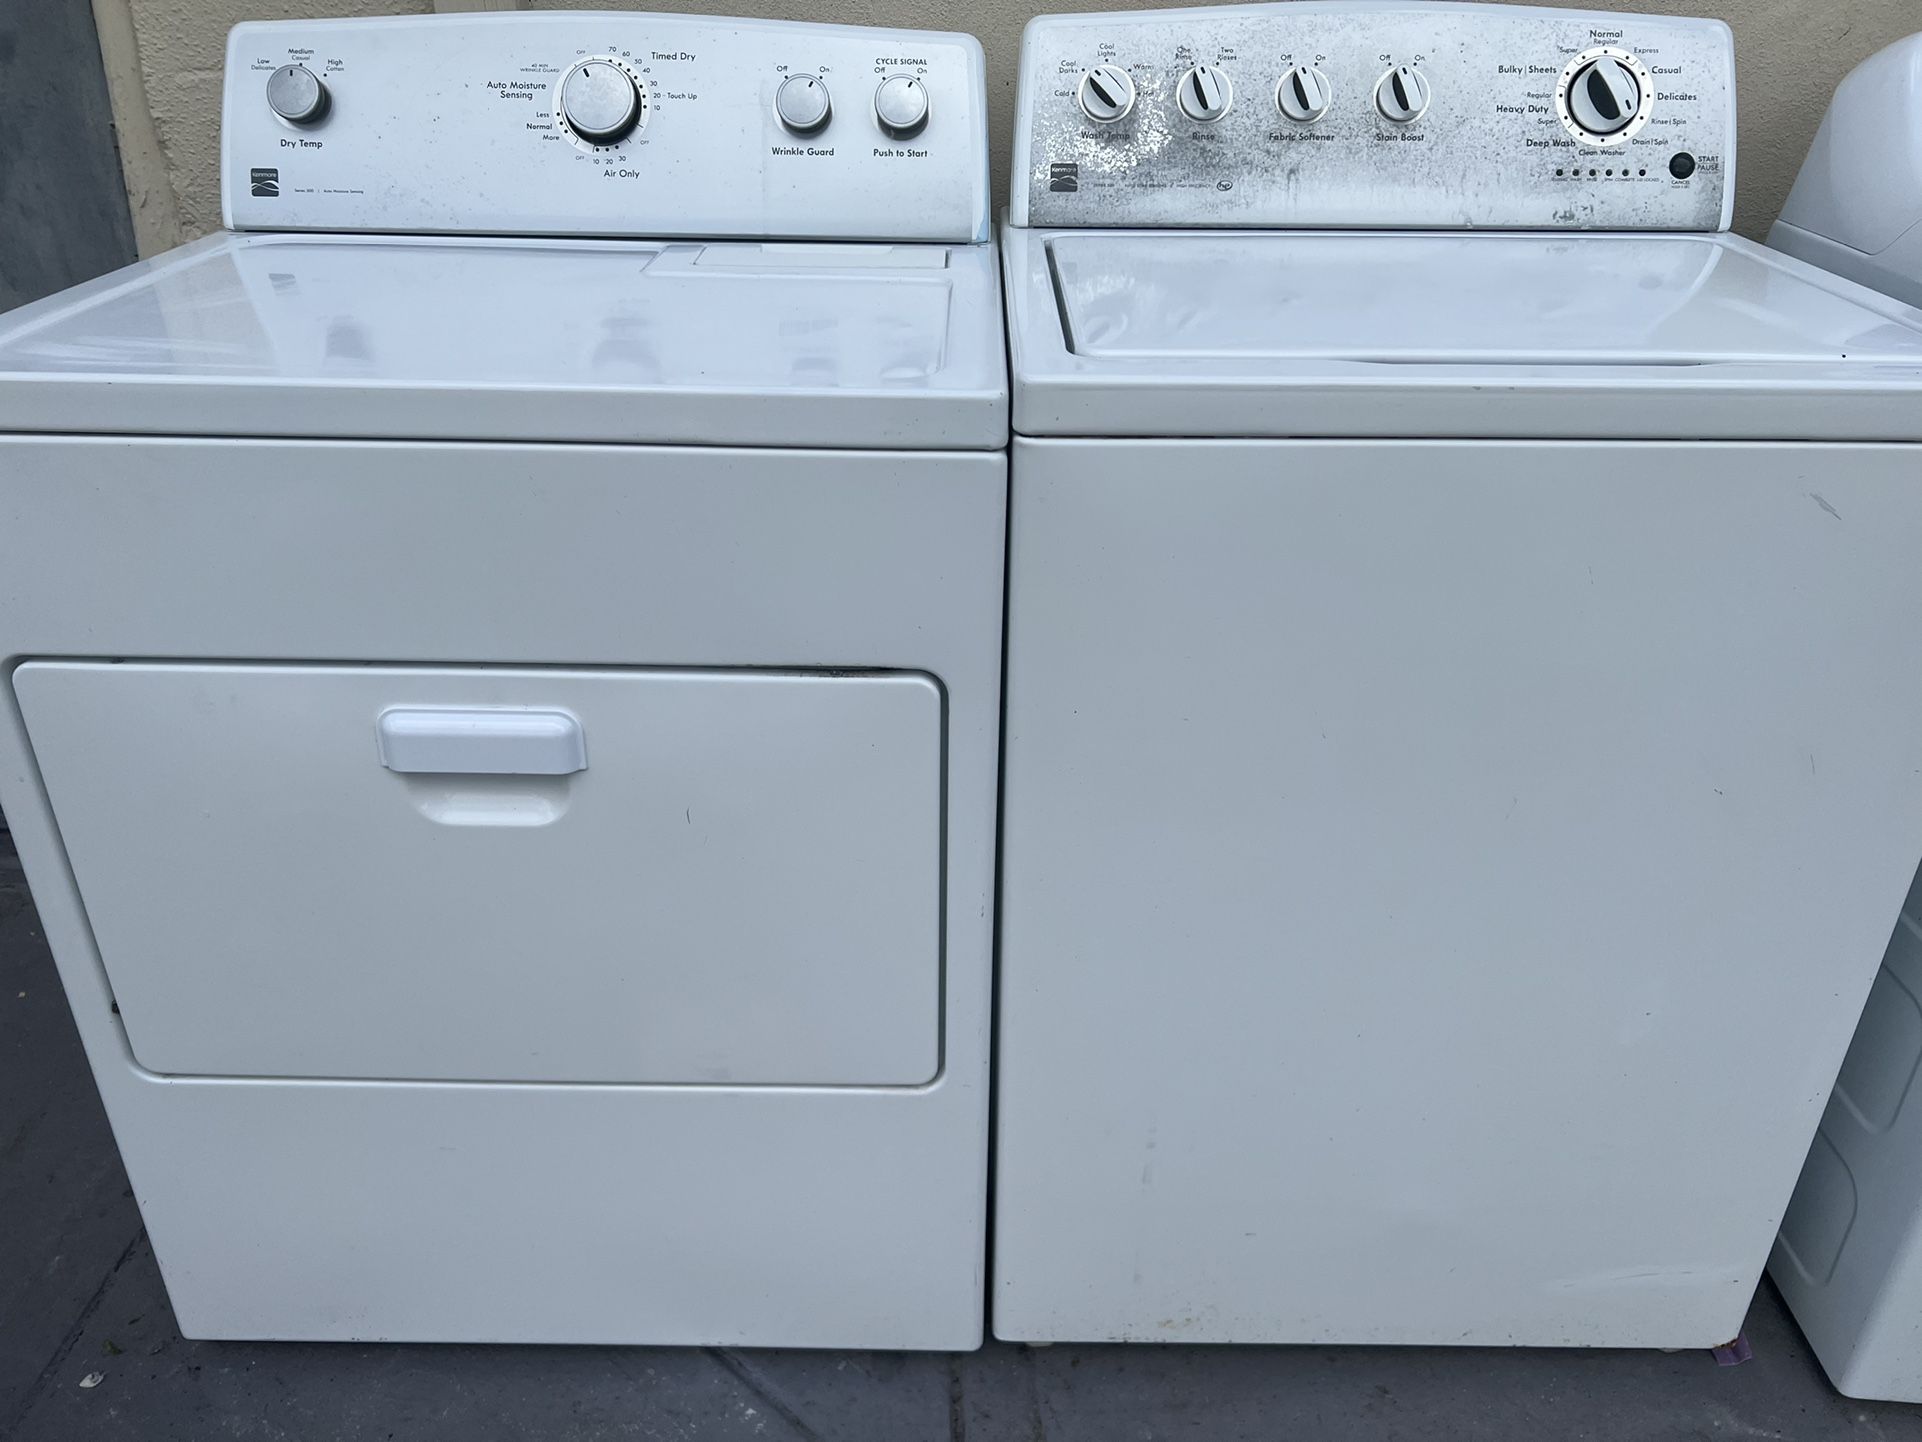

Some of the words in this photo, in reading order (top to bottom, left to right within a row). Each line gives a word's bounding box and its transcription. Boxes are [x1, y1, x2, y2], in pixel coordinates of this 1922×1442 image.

[652, 51, 677, 60] Timed
[680, 52, 696, 61] Dry
[1652, 66, 1682, 74] Casual
[486, 80, 507, 89] Auto
[510, 81, 546, 90] Moisture
[500, 90, 533, 100] Sensing
[688, 93, 698, 101] Up
[1657, 93, 1697, 101] Delicates
[1496, 105, 1525, 114] Heavy
[1528, 105, 1549, 114] Duty
[1538, 118, 1557, 126] Super
[1081, 131, 1106, 140] Wash
[1106, 131, 1130, 141] Temp
[1192, 132, 1215, 140] Rinse
[1269, 132, 1296, 141] Fabric
[1299, 132, 1334, 141] Softener
[1376, 133, 1398, 142] Stain
[1400, 133, 1424, 142] Boost
[280, 138, 296, 148] Dry
[299, 139, 323, 150] Temp
[1526, 140, 1550, 148] Deep
[1552, 139, 1576, 147] Wash
[772, 147, 804, 156] Wrinkle
[807, 148, 834, 156] Guard
[874, 150, 894, 158] Push
[907, 150, 928, 158] Start
[603, 169, 616, 178] Air
[618, 169, 640, 179] Only
